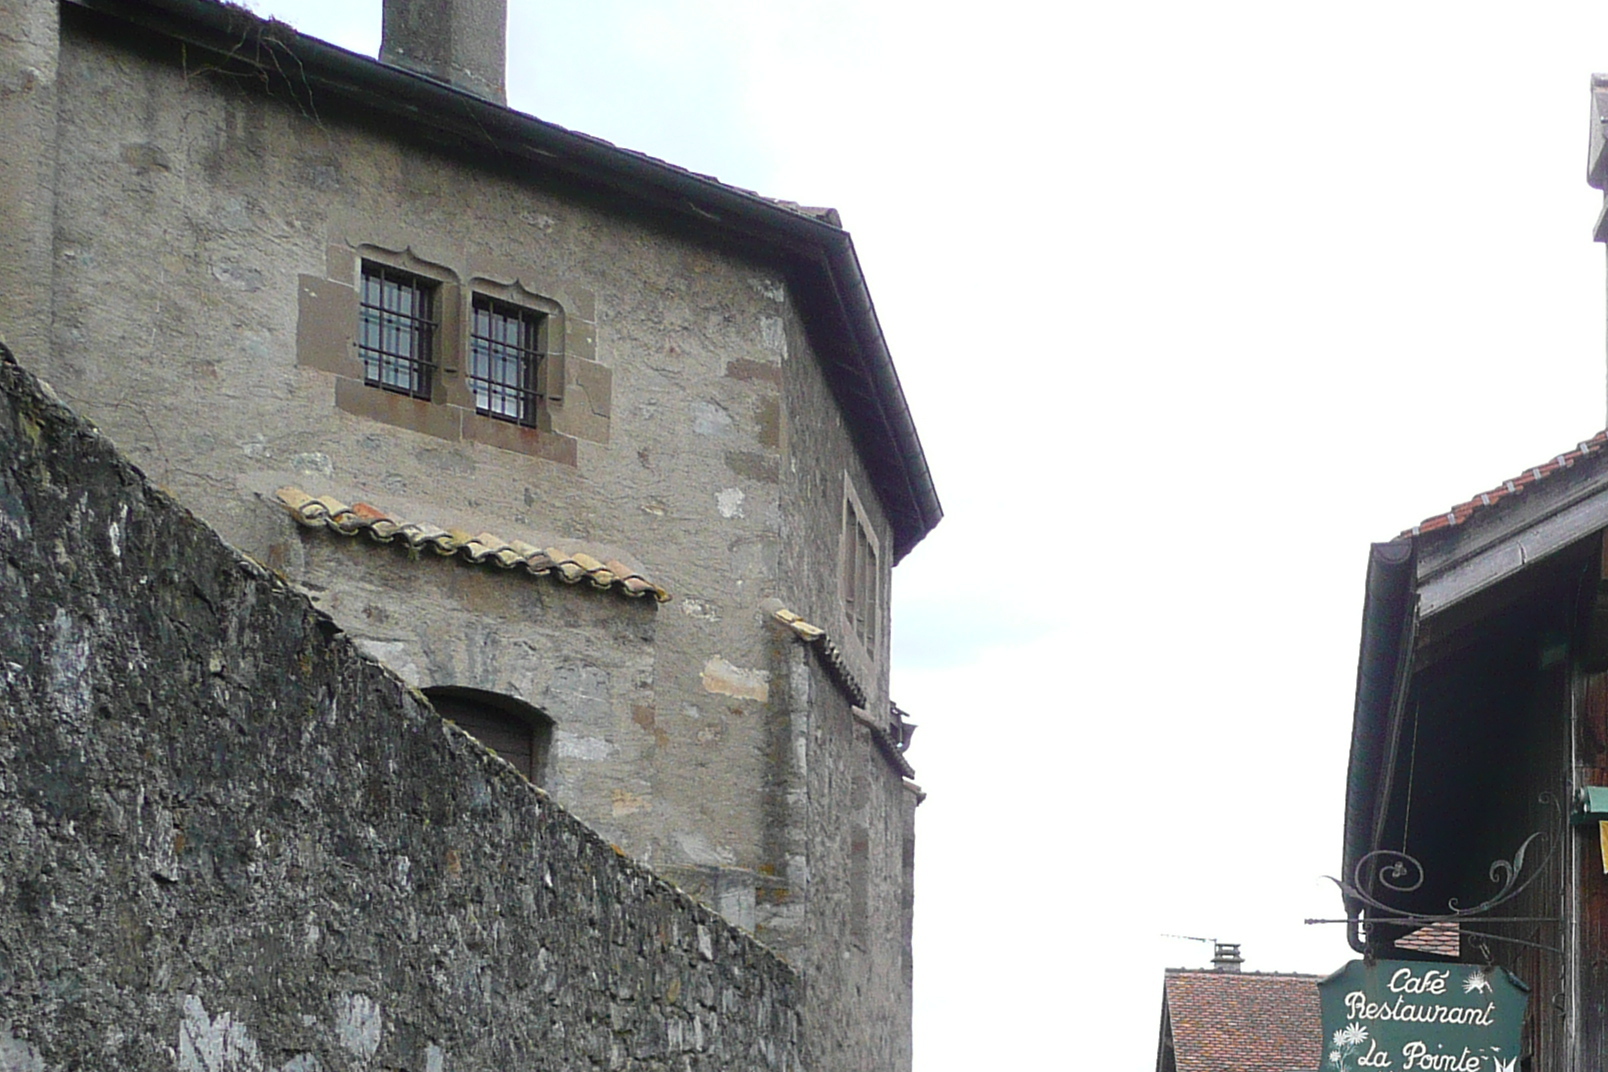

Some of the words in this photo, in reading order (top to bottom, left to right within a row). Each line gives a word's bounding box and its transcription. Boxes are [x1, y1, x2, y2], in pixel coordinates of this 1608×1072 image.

[1386, 967, 1450, 995] Café
[1344, 991, 1495, 1026] Restaurant
[1357, 1038, 1392, 1069] La
